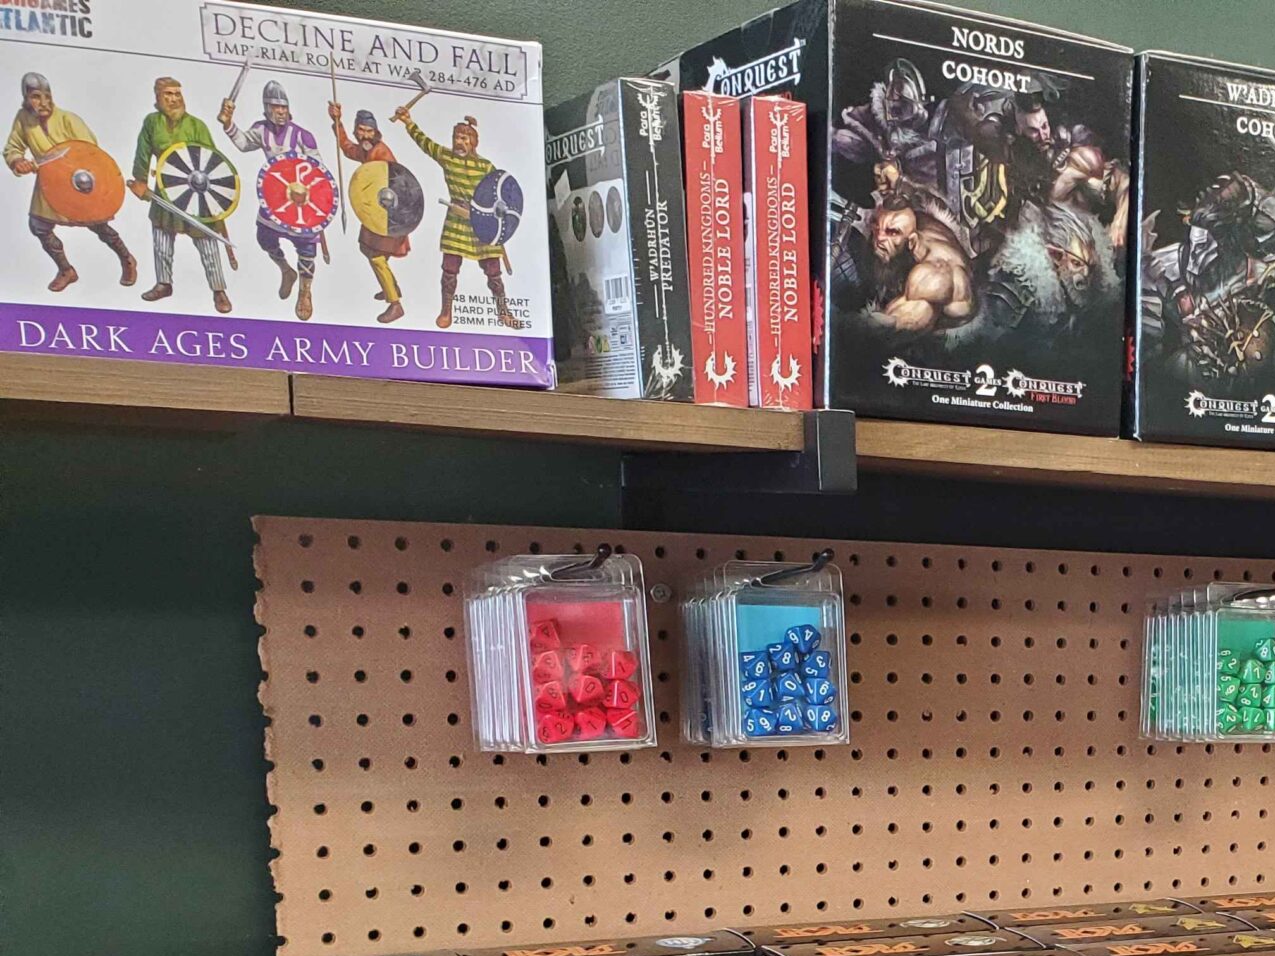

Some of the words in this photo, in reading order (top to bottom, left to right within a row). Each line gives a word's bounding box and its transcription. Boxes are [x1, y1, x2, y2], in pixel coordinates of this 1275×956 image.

[0, 7, 93, 38] TLANTIC
[213, 12, 354, 53] DECLINE
[369, 34, 438, 64] AND
[451, 46, 518, 77] FALL
[952, 27, 1025, 58] NORDS
[306, 53, 355, 71] ROME
[362, 61, 382, 75] AT
[428, 70, 488, 89] 284-476
[494, 79, 516, 92] AD
[941, 60, 1031, 94] COHORT
[699, 170, 713, 254] KINGDOMS
[715, 178, 730, 243] LORD
[766, 175, 779, 258] KINGDOMS
[782, 182, 797, 247] LORD
[657, 200, 675, 292] PREDATOR
[452, 294, 466, 303] 48
[702, 255, 716, 334] HUNDRED
[717, 245, 733, 319] NOBLE
[769, 259, 781, 337] HUNDRED
[784, 249, 797, 322] NOBLE
[453, 316, 485, 325] 28MM
[487, 318, 532, 329] FIGURES
[454, 306, 484, 315] HARD
[487, 307, 530, 318] PLASTIC
[16, 320, 134, 355] DARK
[149, 328, 249, 360] AGES
[269, 335, 376, 368] ARMY
[391, 343, 539, 374] BUILDER
[882, 357, 971, 388] CONQUEST
[1003, 368, 1083, 398] CONQUEST
[931, 395, 949, 405] One
[951, 396, 991, 409] Miniature
[993, 400, 1034, 413] Collection
[1184, 390, 1258, 418] CONQUEST
[1225, 424, 1239, 432] One
[1241, 425, 1274, 434] Miniature
